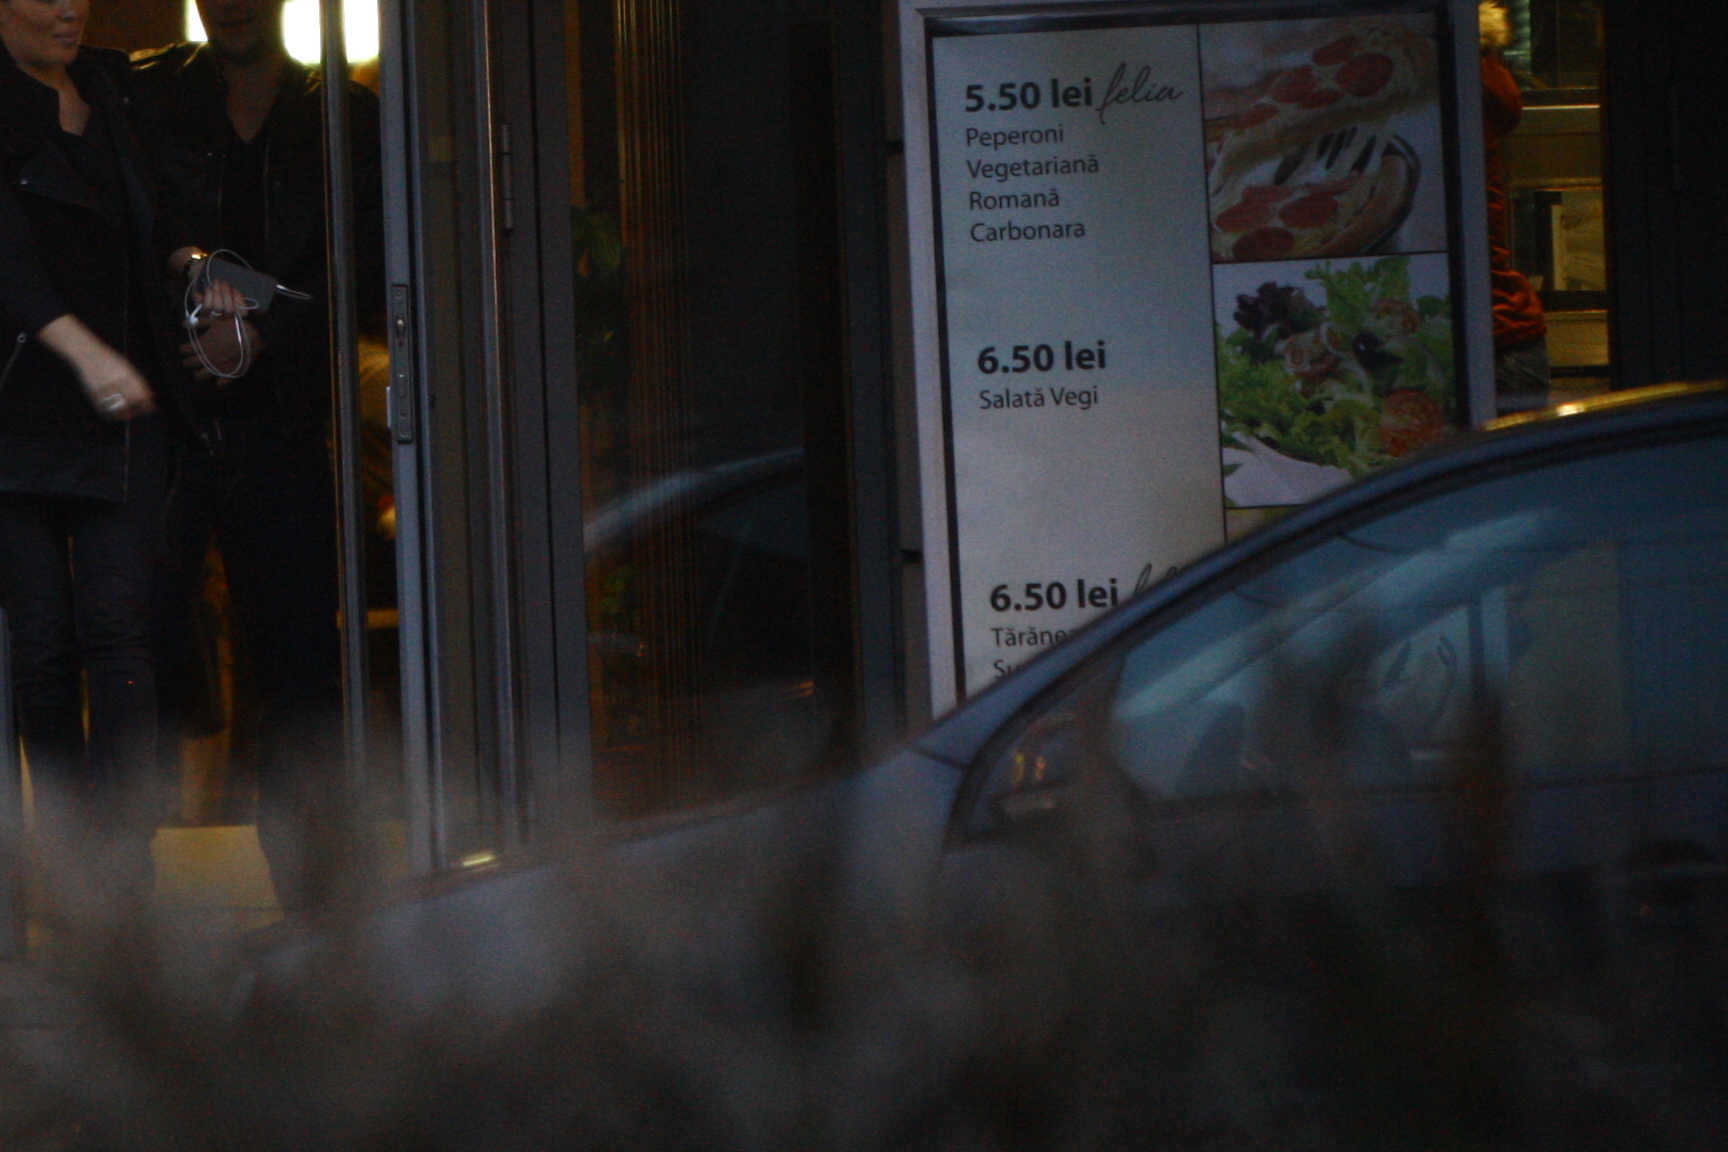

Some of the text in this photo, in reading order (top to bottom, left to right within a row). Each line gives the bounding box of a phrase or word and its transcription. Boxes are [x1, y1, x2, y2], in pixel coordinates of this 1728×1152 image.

[965, 82, 1041, 113] 5.50
[1051, 77, 1093, 108] lei
[966, 123, 1065, 150] Peperoni
[966, 154, 1099, 183] Vegetariană
[969, 188, 1060, 211] Romană
[971, 221, 1086, 242] Carbonara
[978, 340, 1107, 374] 6.50 lei
[980, 385, 1098, 410] Salată Vegi
[990, 582, 1067, 612] 6.50
[1077, 578, 1120, 609] lei
